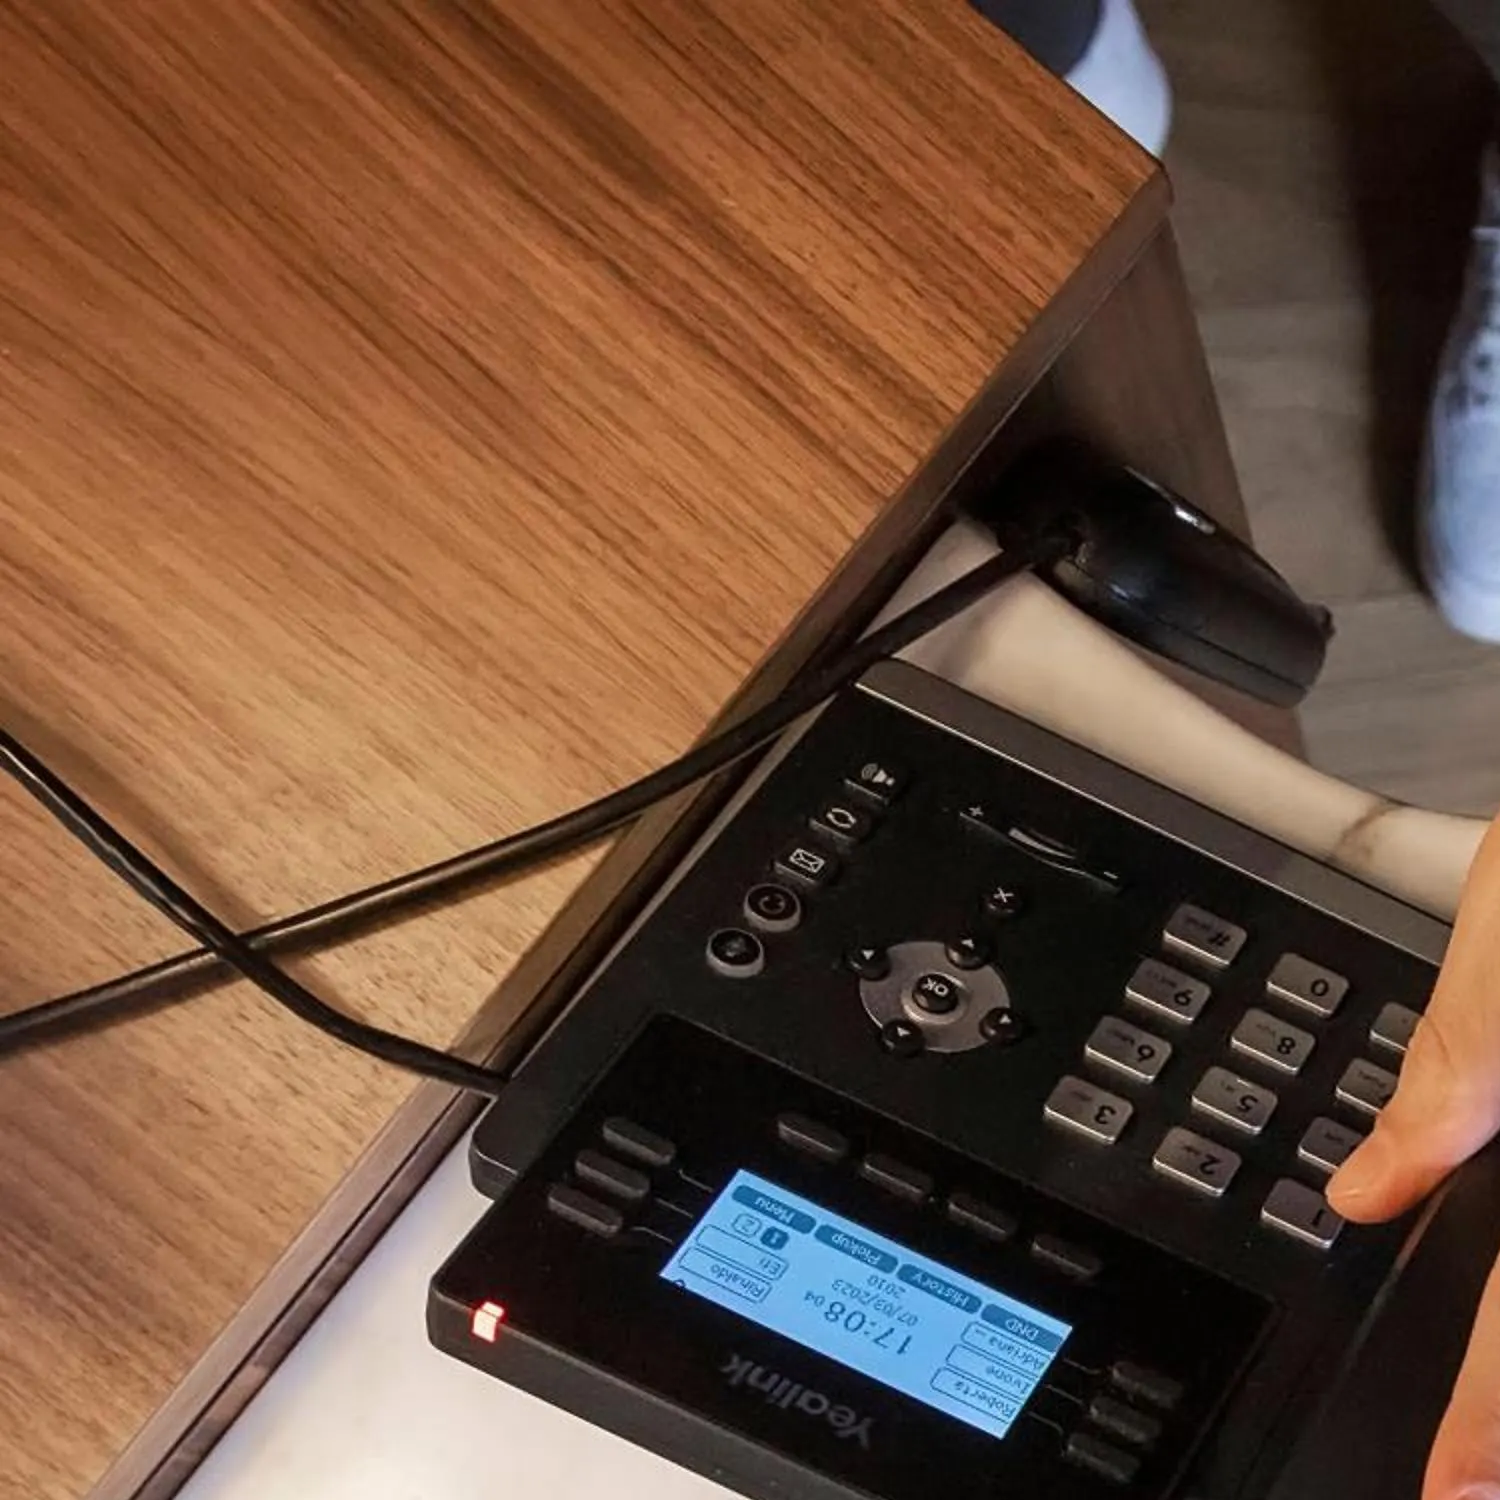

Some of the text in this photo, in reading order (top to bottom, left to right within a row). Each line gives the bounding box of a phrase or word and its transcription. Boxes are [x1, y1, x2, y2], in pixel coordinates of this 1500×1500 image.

[921, 975, 950, 998] OK
[1171, 983, 1195, 1007] 9
[1308, 975, 1331, 999] 0
[1132, 1041, 1156, 1066] 6
[1275, 1033, 1298, 1057] 8
[1093, 1102, 1116, 1127] 3
[1235, 1091, 1258, 1115] 5
[1197, 1152, 1220, 1176] 2
[753, 1193, 795, 1223] Menu
[829, 1230, 881, 1266] Pickup
[909, 1266, 970, 1309] History
[830, 1272, 920, 1330] 07/03/2023
[822, 1295, 913, 1354] 17:08
[1002, 1313, 1039, 1342] DND
[720, 1352, 874, 1448] Yealink
